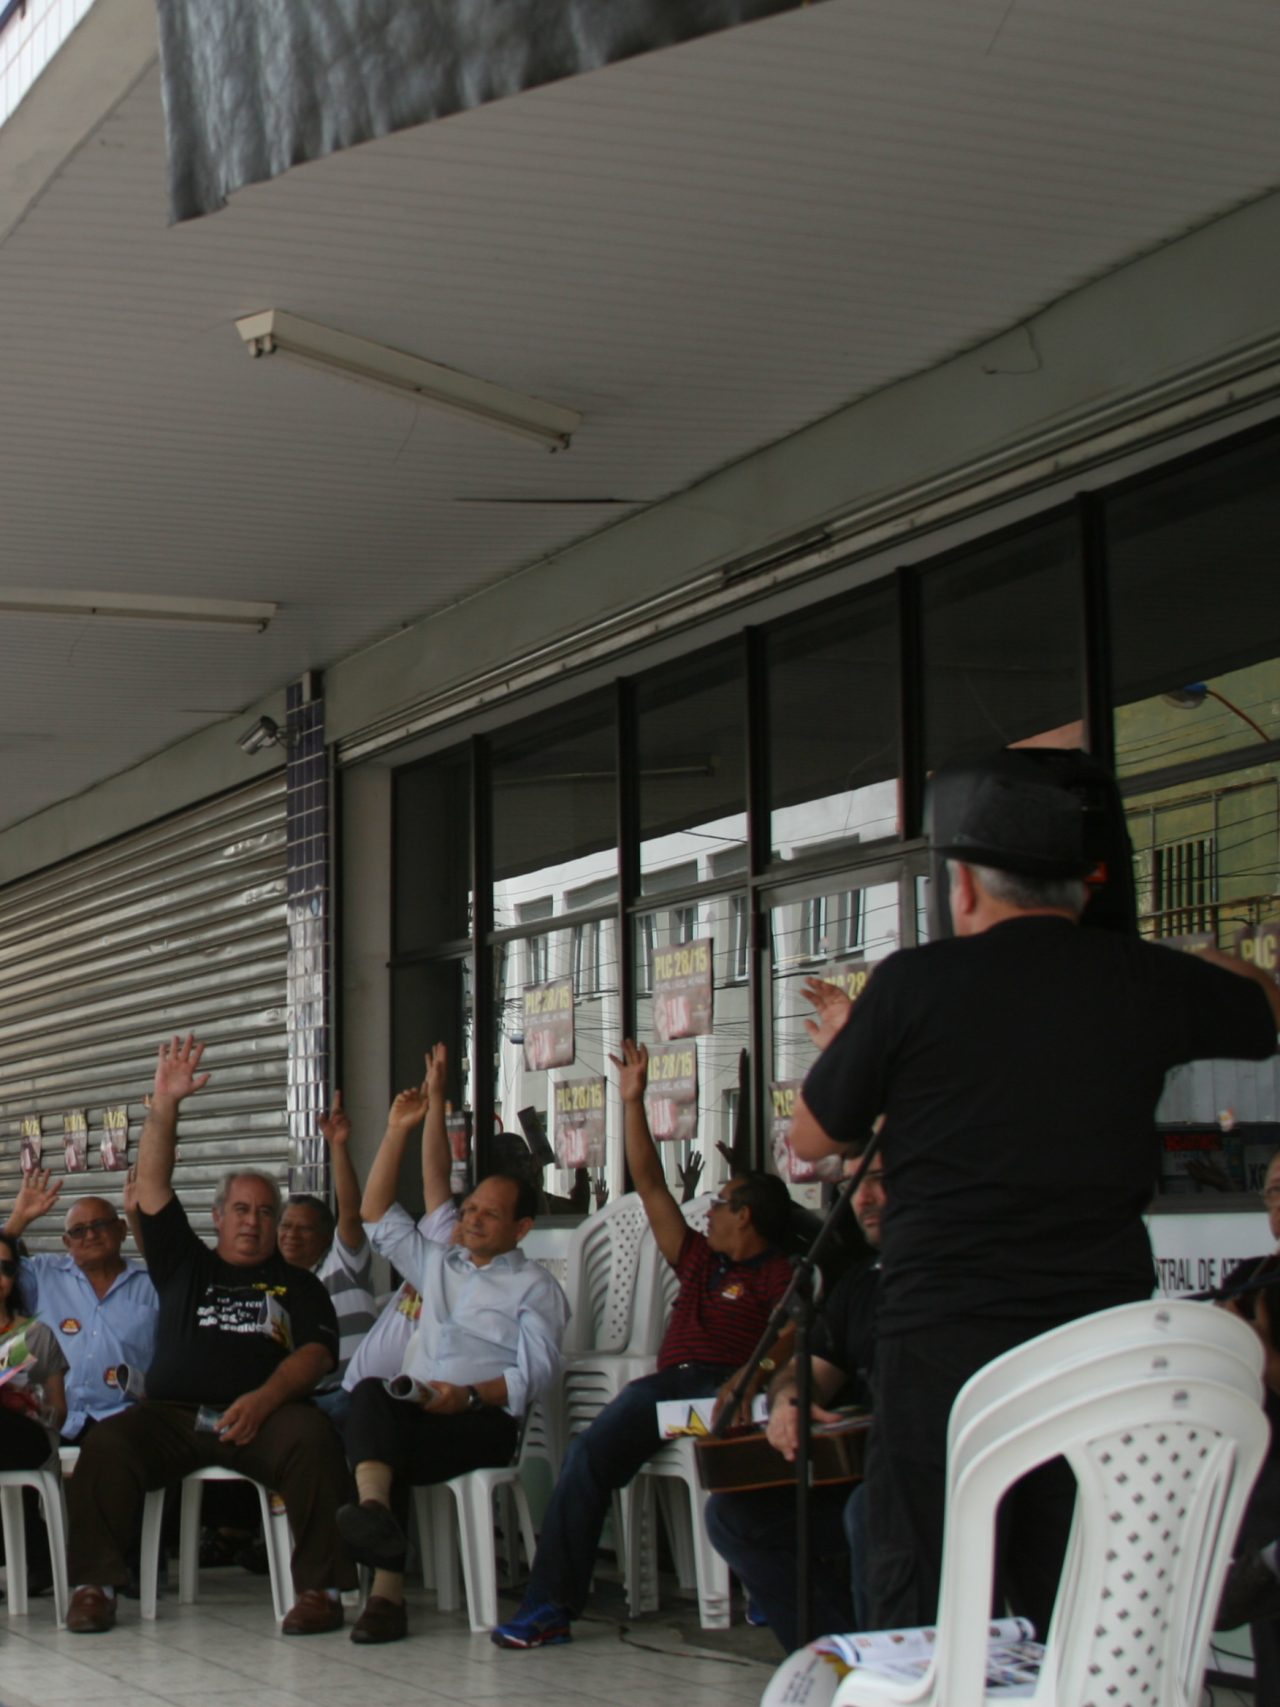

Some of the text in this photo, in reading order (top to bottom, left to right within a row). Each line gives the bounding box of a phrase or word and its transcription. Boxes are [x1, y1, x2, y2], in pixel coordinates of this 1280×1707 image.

[655, 946, 707, 981] PLC 28/15
[524, 985, 570, 1016] PLC 28/15
[648, 1051, 693, 1082] LC 28/15
[556, 1083, 602, 1113] PLC 28/15
[1198, 1258, 1216, 1291] DE
